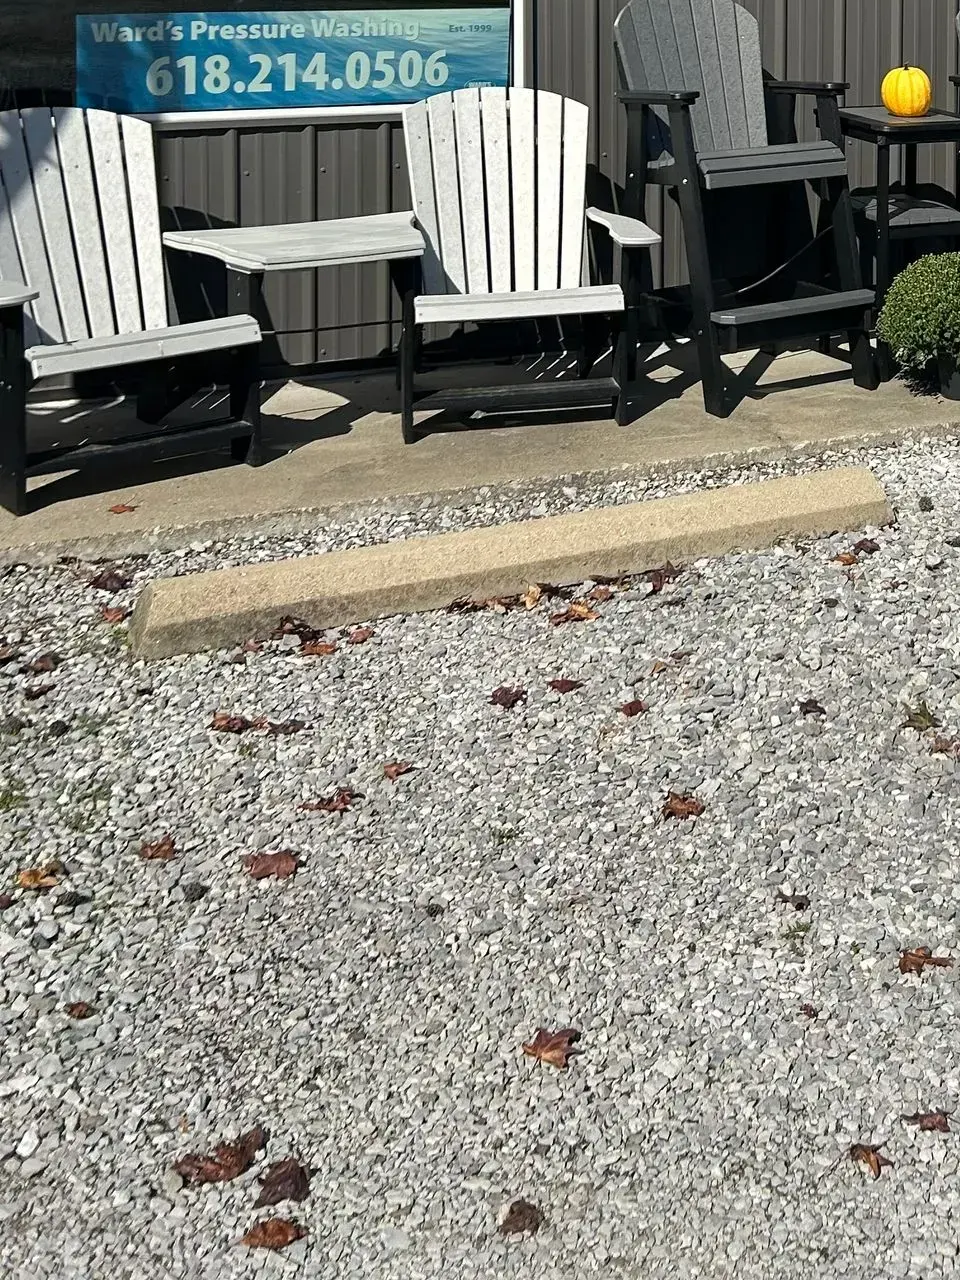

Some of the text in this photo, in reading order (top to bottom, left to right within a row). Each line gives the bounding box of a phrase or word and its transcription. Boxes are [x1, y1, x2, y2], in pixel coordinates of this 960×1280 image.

[91, 16, 420, 44] Ward's Pressure Washing
[449, 24, 492, 33] Est. 1999
[146, 50, 449, 97] 618.214.0506
